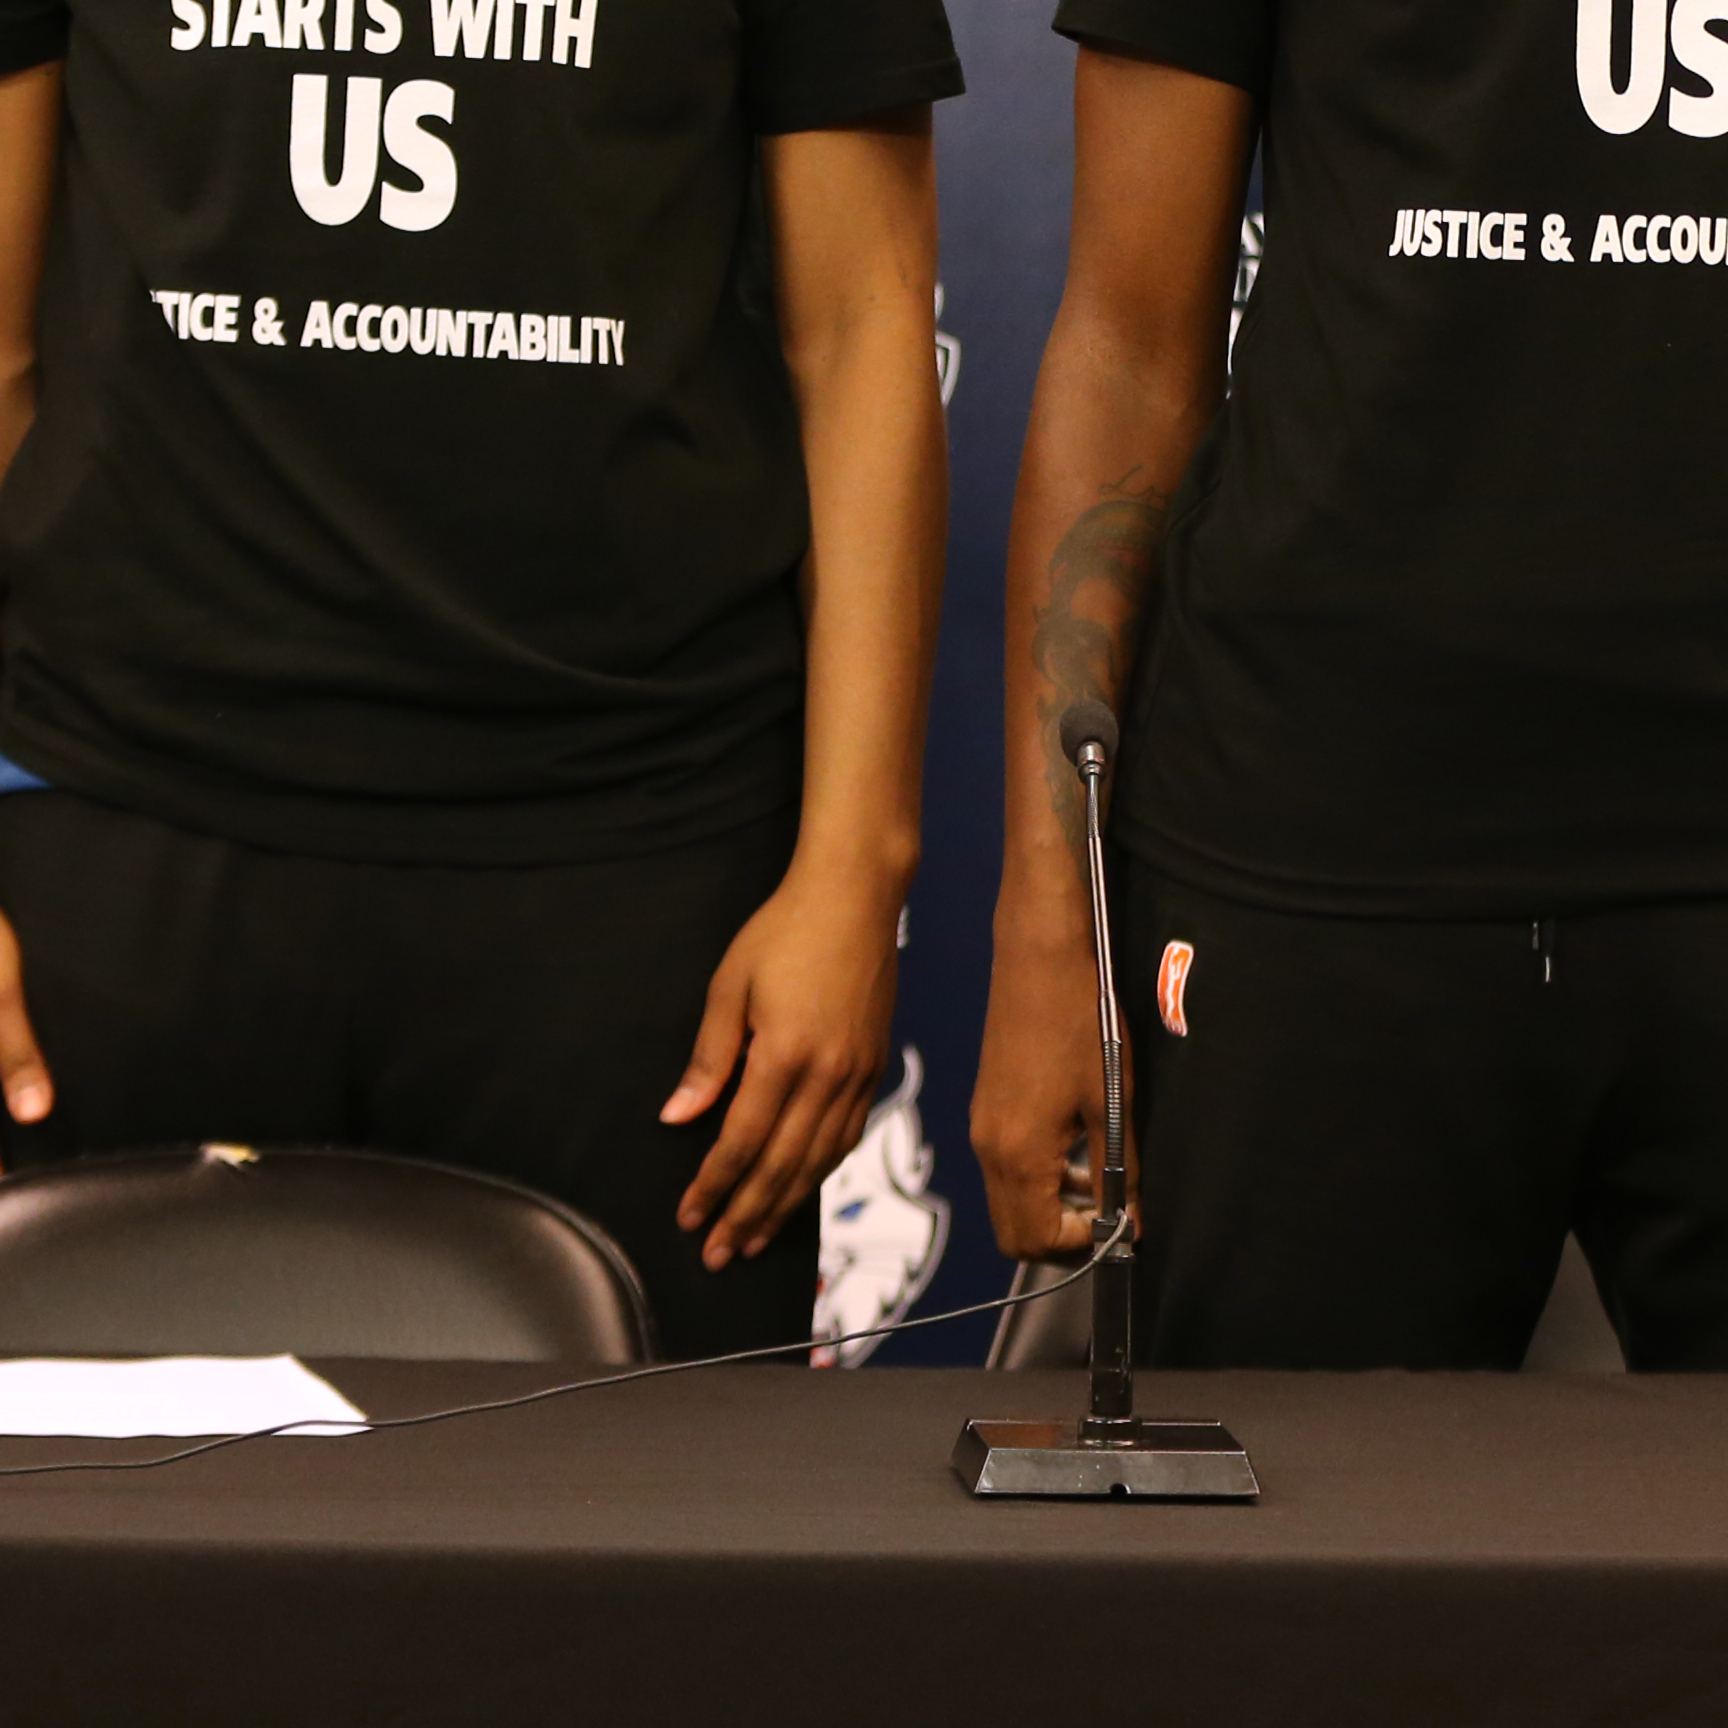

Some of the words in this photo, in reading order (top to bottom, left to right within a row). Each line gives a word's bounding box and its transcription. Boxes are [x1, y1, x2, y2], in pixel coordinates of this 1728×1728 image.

[289, 73, 458, 232] US
[1389, 209, 1527, 261] JUSTICE
[1540, 213, 1574, 263] &
[252, 296, 287, 347] &
[300, 300, 625, 366] ACCOUNTABILITY
